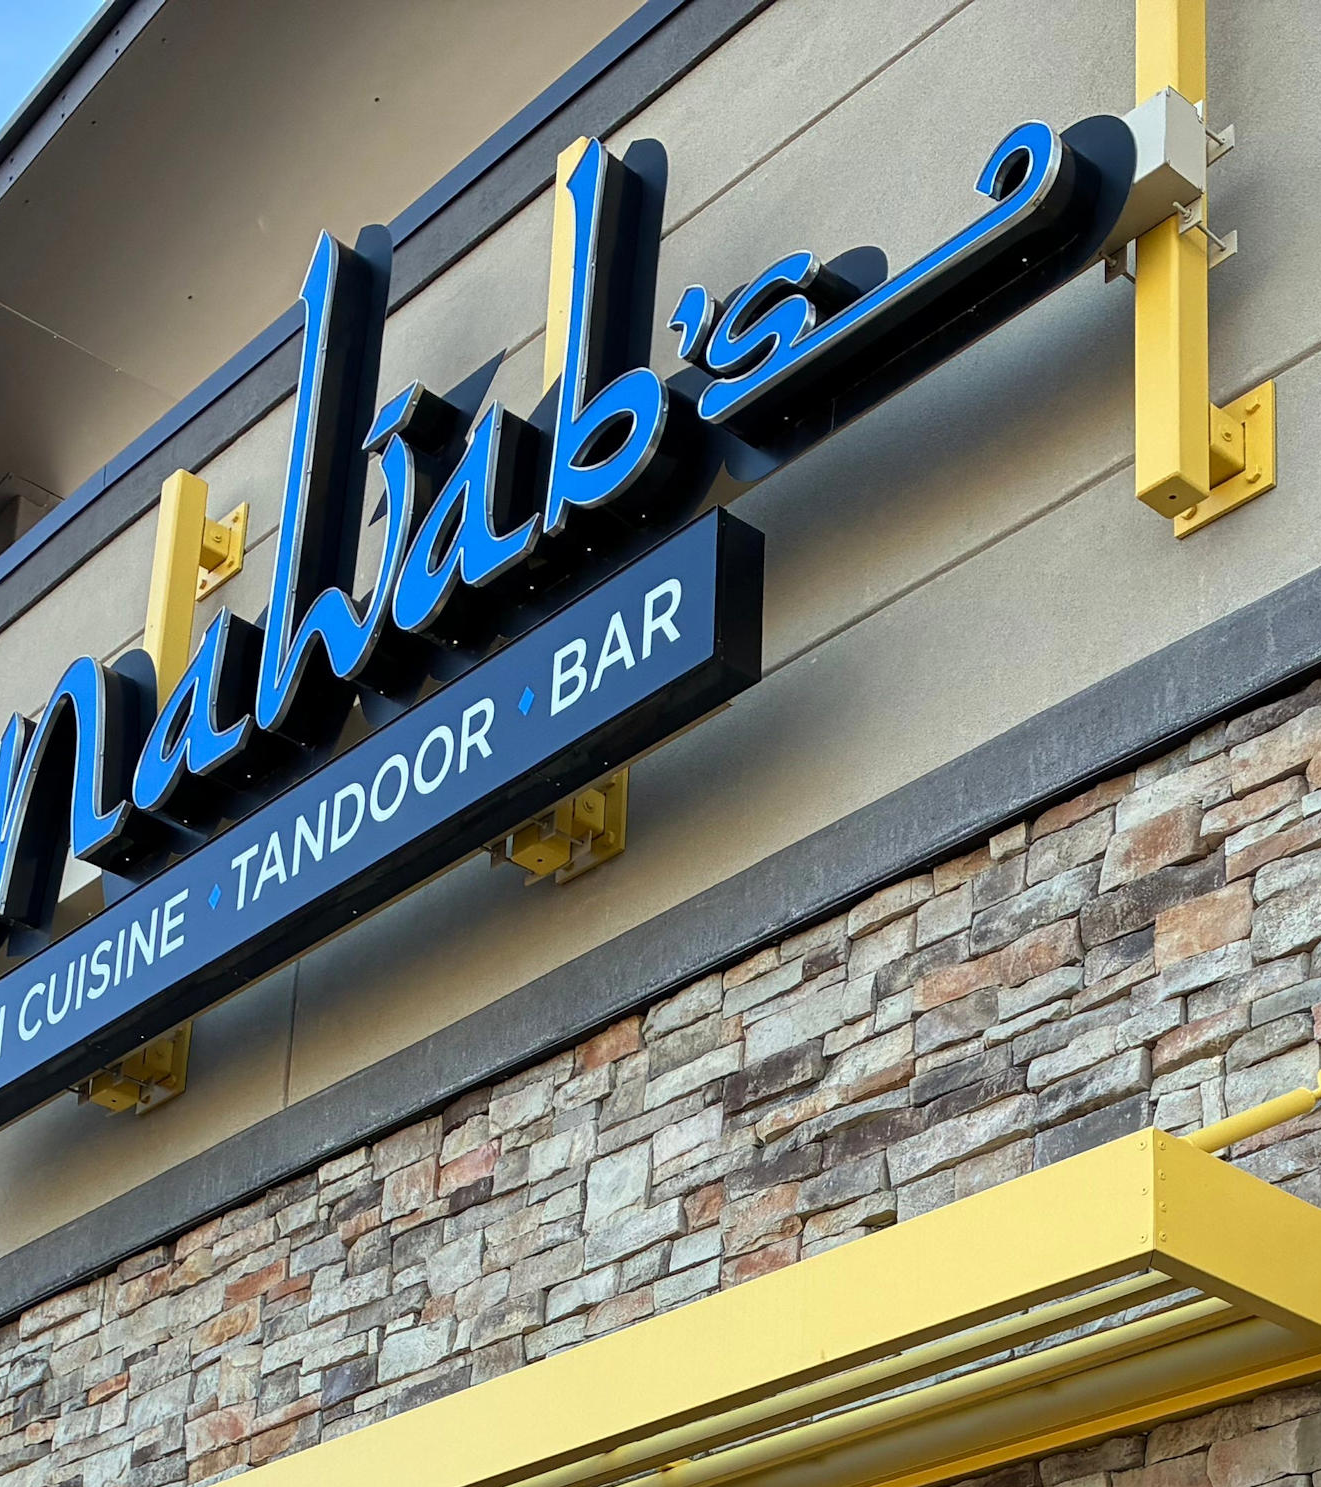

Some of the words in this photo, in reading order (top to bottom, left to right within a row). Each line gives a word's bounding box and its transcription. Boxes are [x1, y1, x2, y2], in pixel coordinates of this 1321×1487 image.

[16, 887, 190, 1044] CUISINE
[229, 695, 497, 912] TANDOOR
[548, 576, 684, 718] BAR
